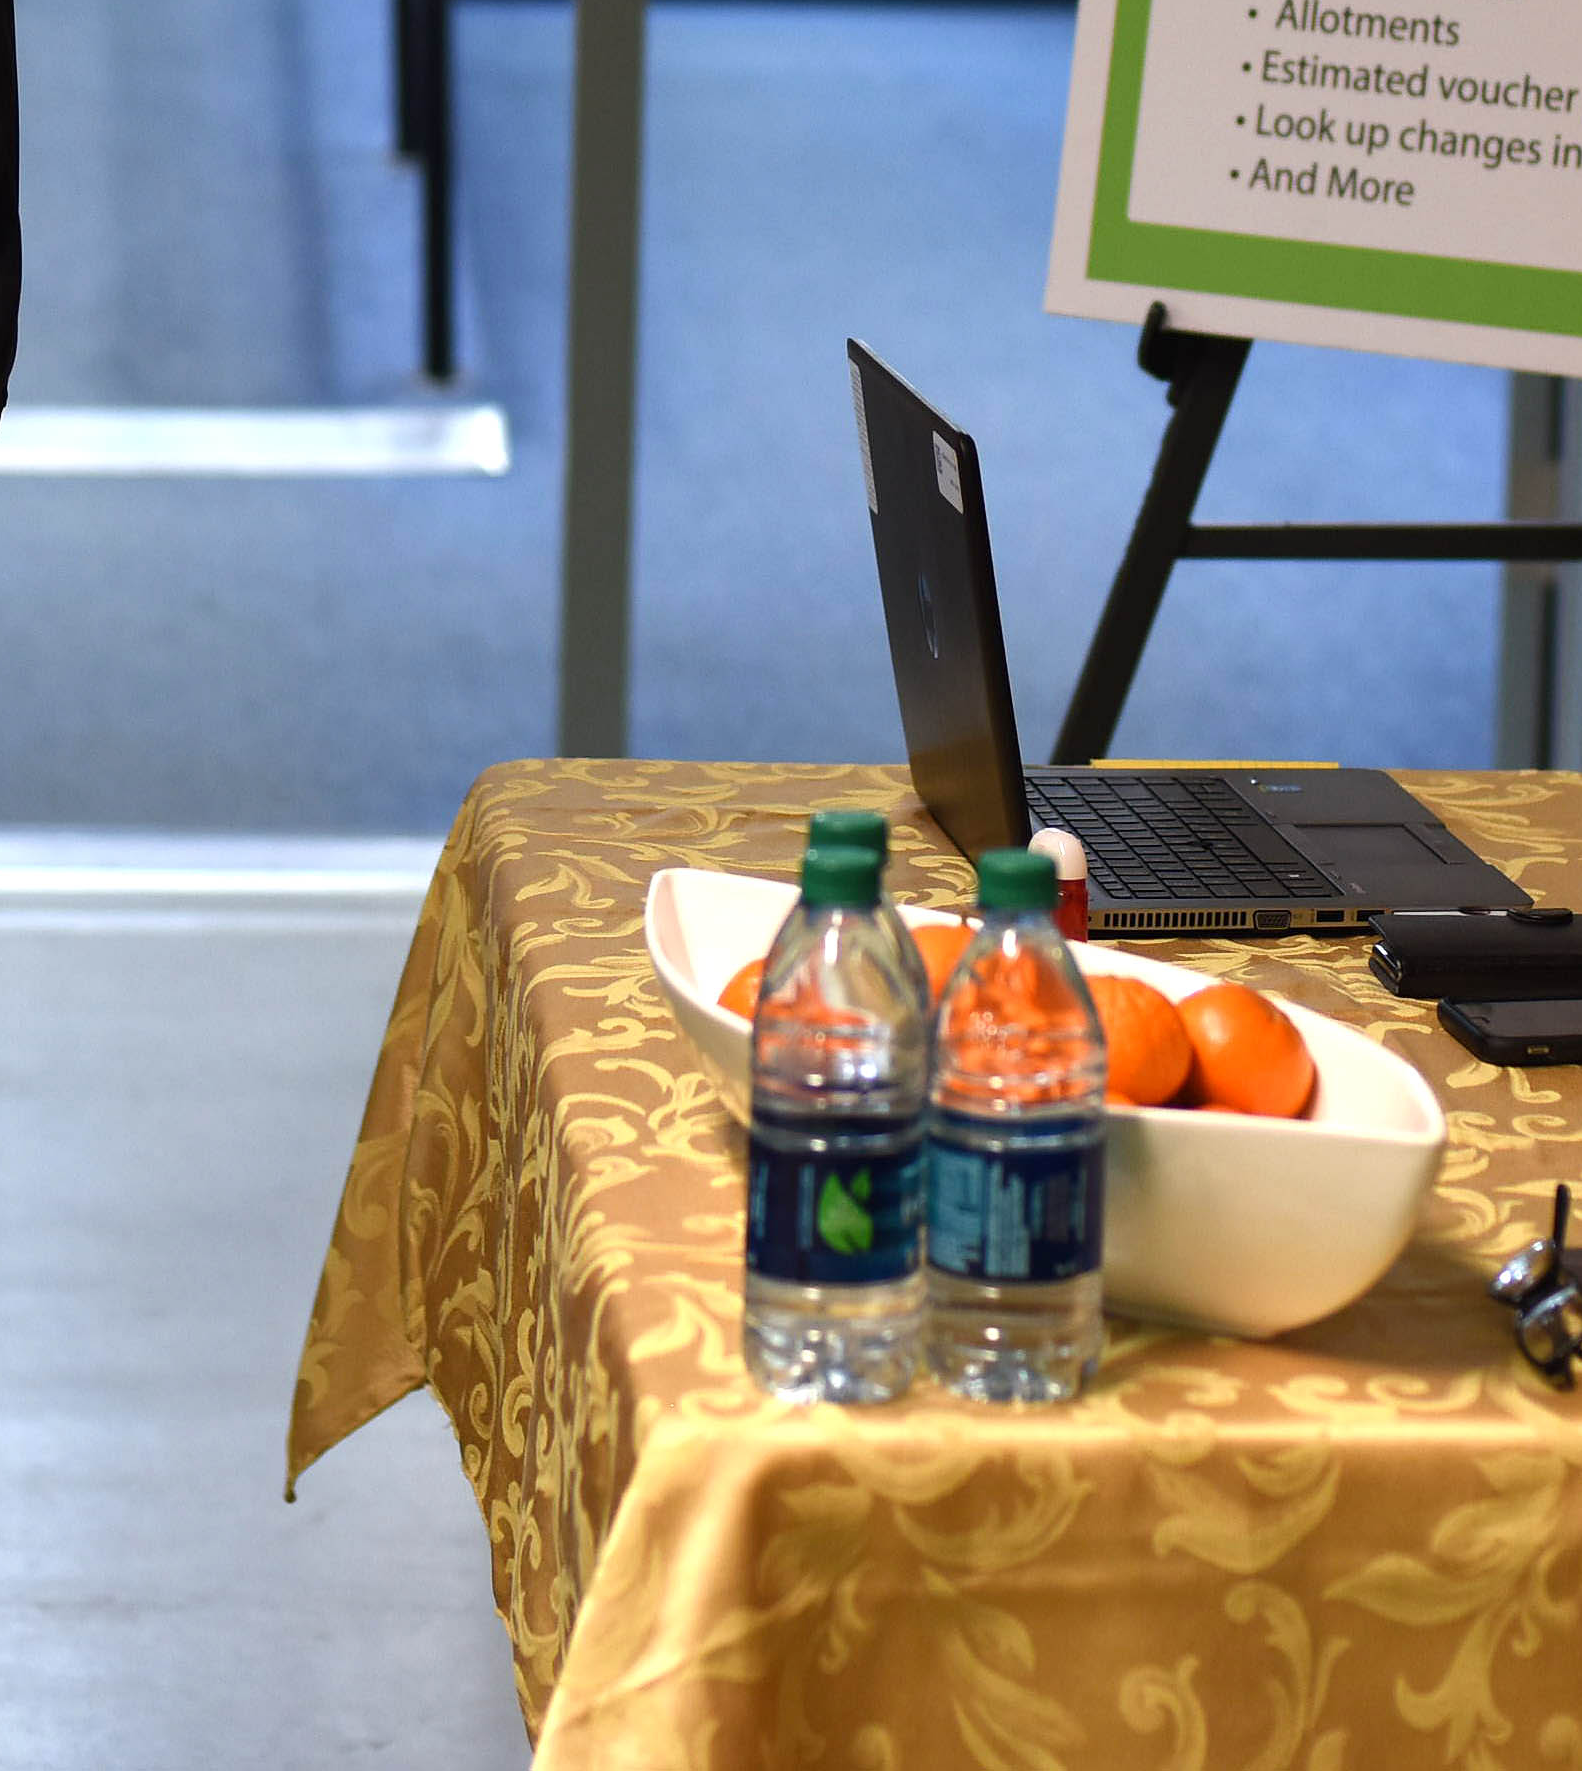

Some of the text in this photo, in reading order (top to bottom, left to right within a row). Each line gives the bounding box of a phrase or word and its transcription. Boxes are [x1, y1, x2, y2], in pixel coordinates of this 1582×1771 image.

[1261, 49, 1429, 98] Estimated
[1438, 74, 1579, 113] voucher
[1255, 103, 1336, 143] Look
[1346, 122, 1390, 156] up
[1398, 119, 1542, 170] changes
[1552, 134, 1582, 170] in
[1248, 158, 1415, 207] And More
